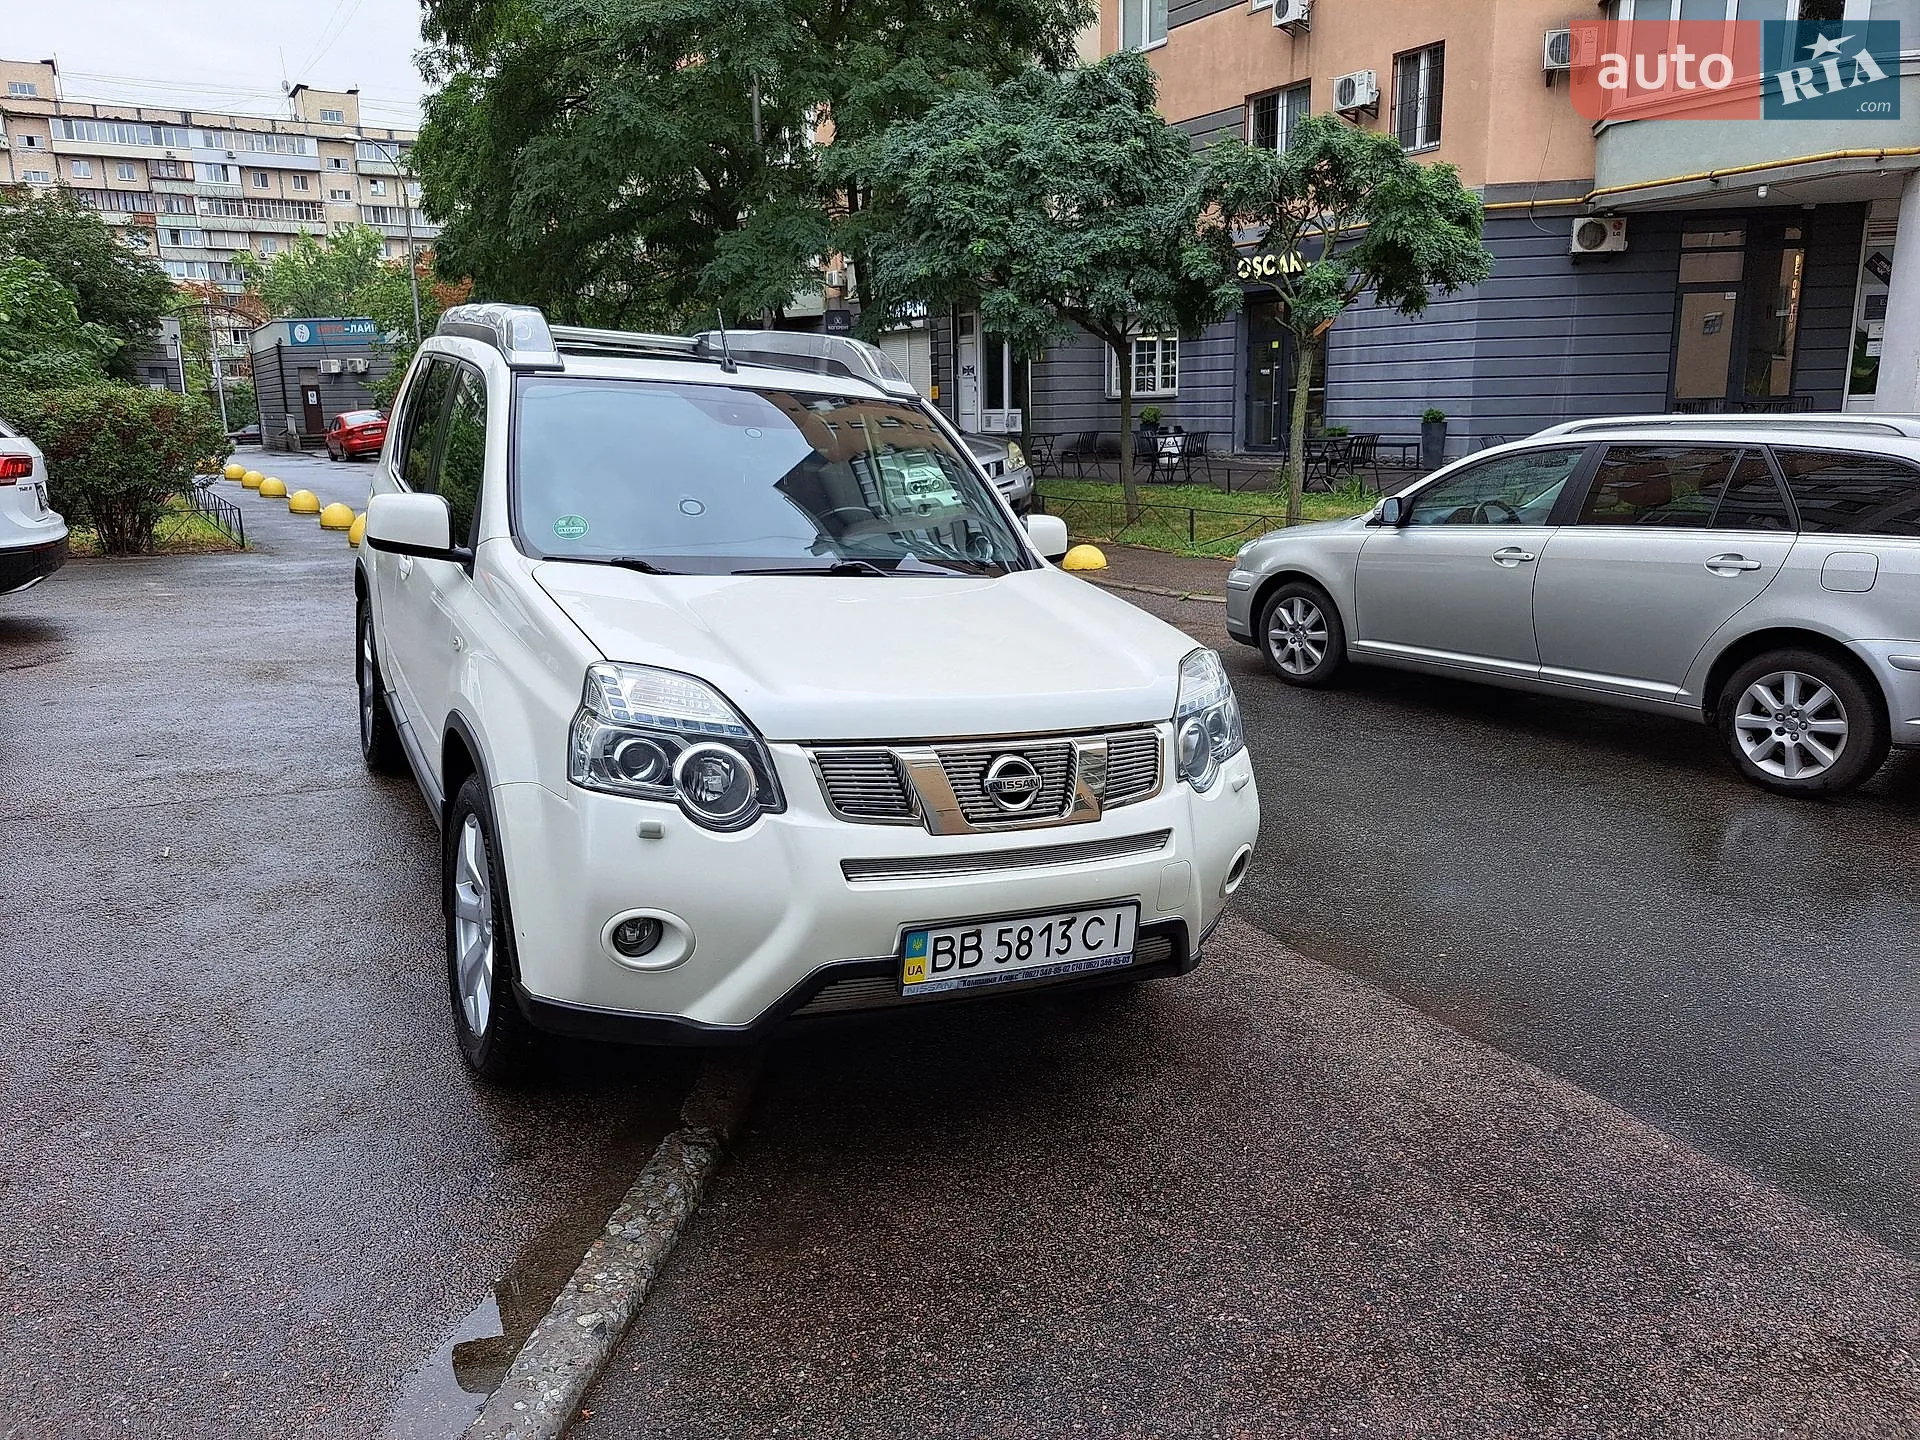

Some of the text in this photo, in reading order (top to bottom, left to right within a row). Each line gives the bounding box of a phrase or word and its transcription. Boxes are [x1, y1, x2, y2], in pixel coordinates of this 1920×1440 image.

[989, 778, 1038, 791] NISSAN
[931, 913, 1122, 974] BB 5813 CI
[907, 966, 923, 976] UA
[904, 981, 954, 995] NISSAN
